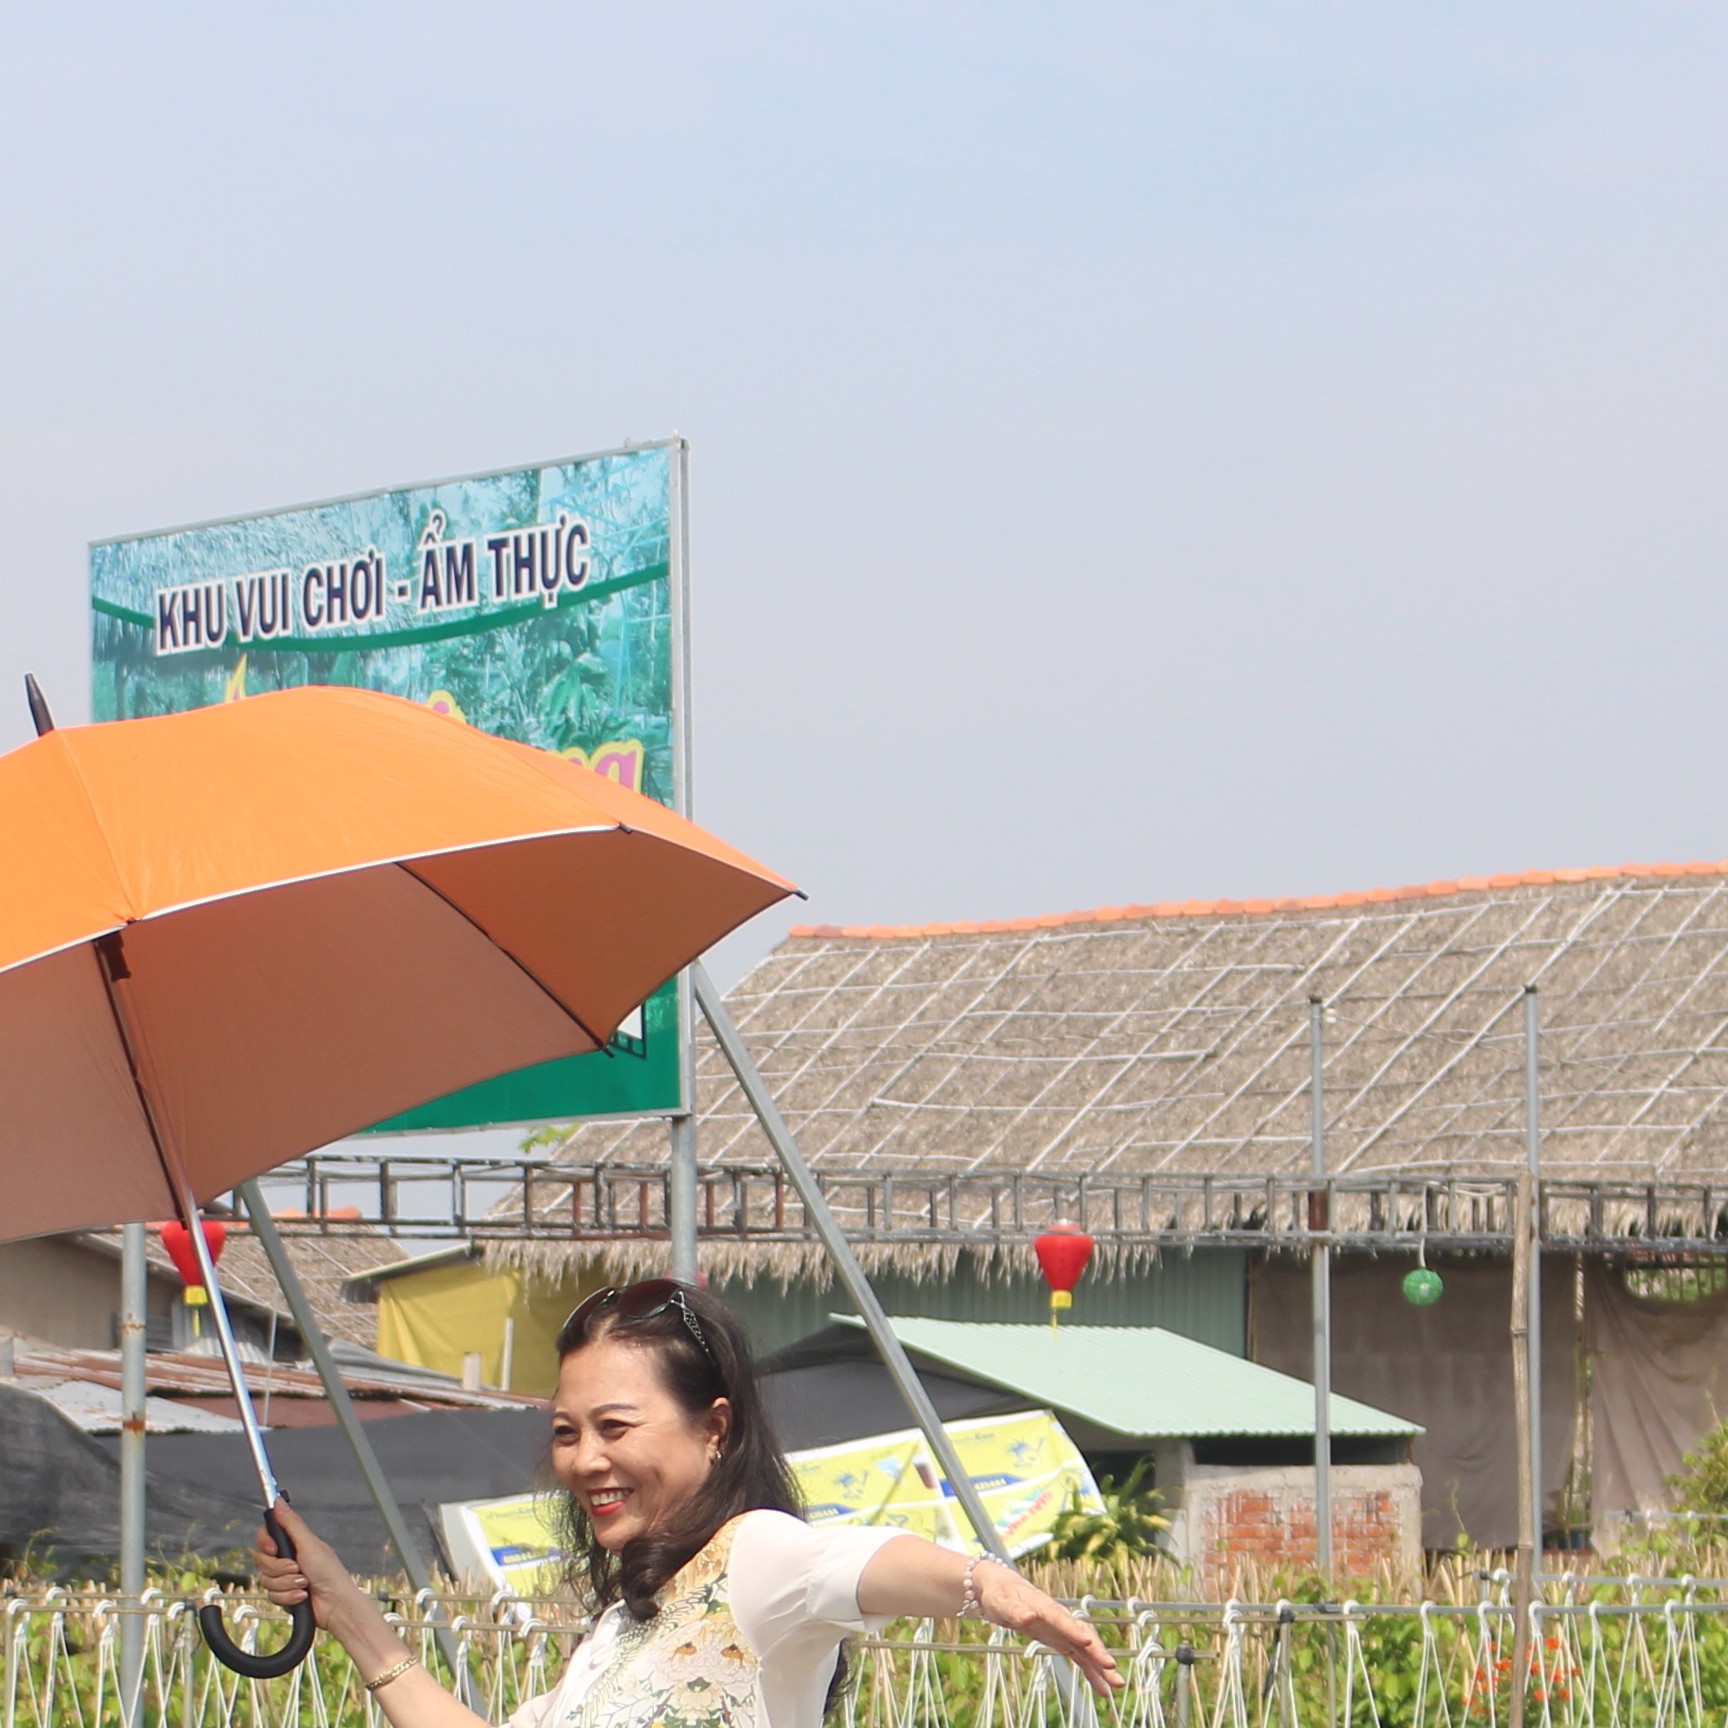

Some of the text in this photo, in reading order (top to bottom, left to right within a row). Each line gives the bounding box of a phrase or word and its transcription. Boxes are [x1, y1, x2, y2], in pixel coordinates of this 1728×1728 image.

[158, 582, 225, 650] KHU
[235, 571, 290, 638] VUI
[302, 547, 384, 628] CHƠI
[420, 512, 477, 610] ẨM
[486, 513, 589, 604] THỰC
